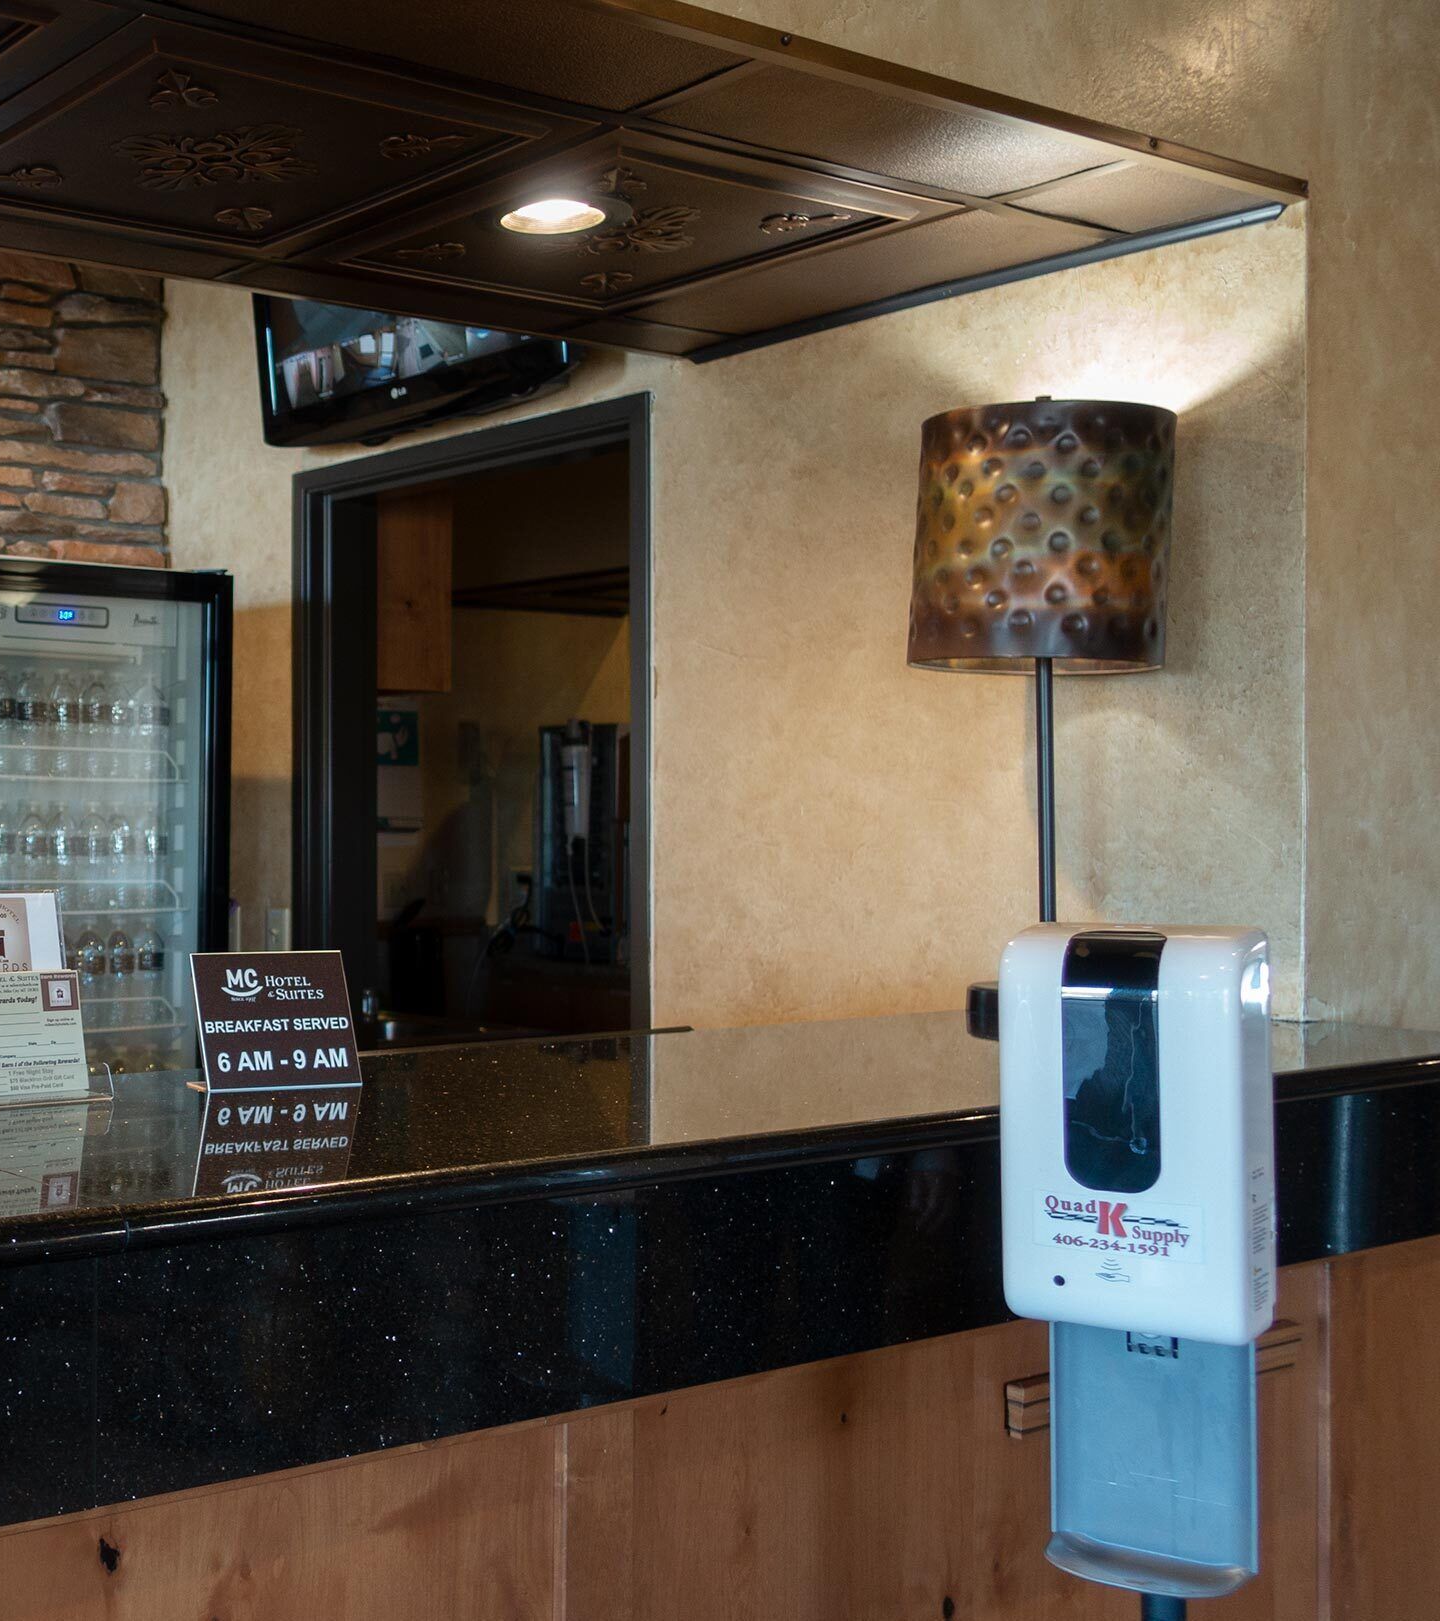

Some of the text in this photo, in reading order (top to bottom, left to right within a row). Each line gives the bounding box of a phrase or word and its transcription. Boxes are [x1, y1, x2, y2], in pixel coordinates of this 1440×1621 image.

[0, 903, 20, 924] HOTEL
[226, 968, 311, 989] MC HOTEL
[17, 996, 38, 1004] Today!
[205, 1017, 349, 1034] BREAKFAST SERVED
[217, 1052, 231, 1072] 6
[238, 1051, 274, 1071] AM
[293, 1050, 306, 1069] 9
[313, 1048, 348, 1068] AM
[1045, 1195, 1190, 1247] Quad K Supply
[1052, 1233, 1170, 1257] 406-234-1591
